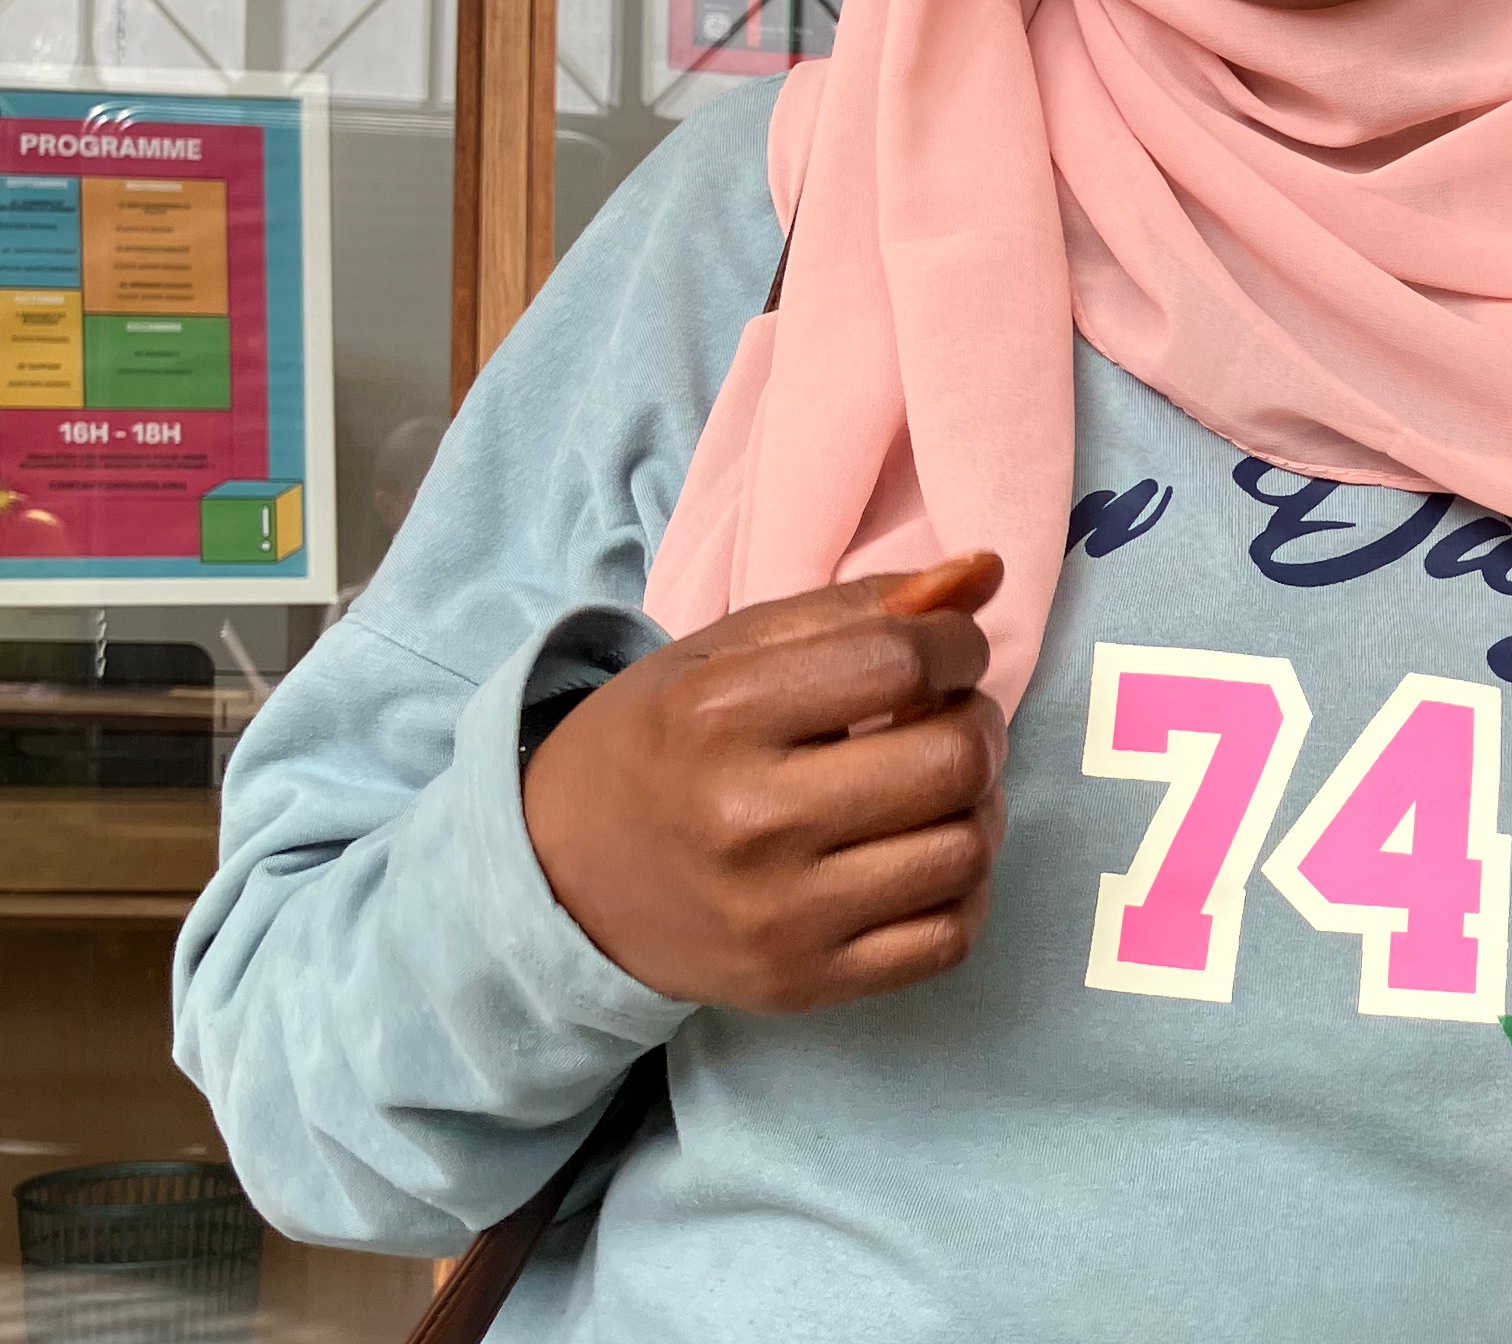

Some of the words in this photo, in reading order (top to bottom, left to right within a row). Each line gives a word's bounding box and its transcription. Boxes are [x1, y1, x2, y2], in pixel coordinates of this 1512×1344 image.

[20, 133, 203, 161] PROGRAMME
[59, 421, 109, 445] 16H
[131, 421, 182, 445] 18H
[1082, 642, 1511, 1024] 74
